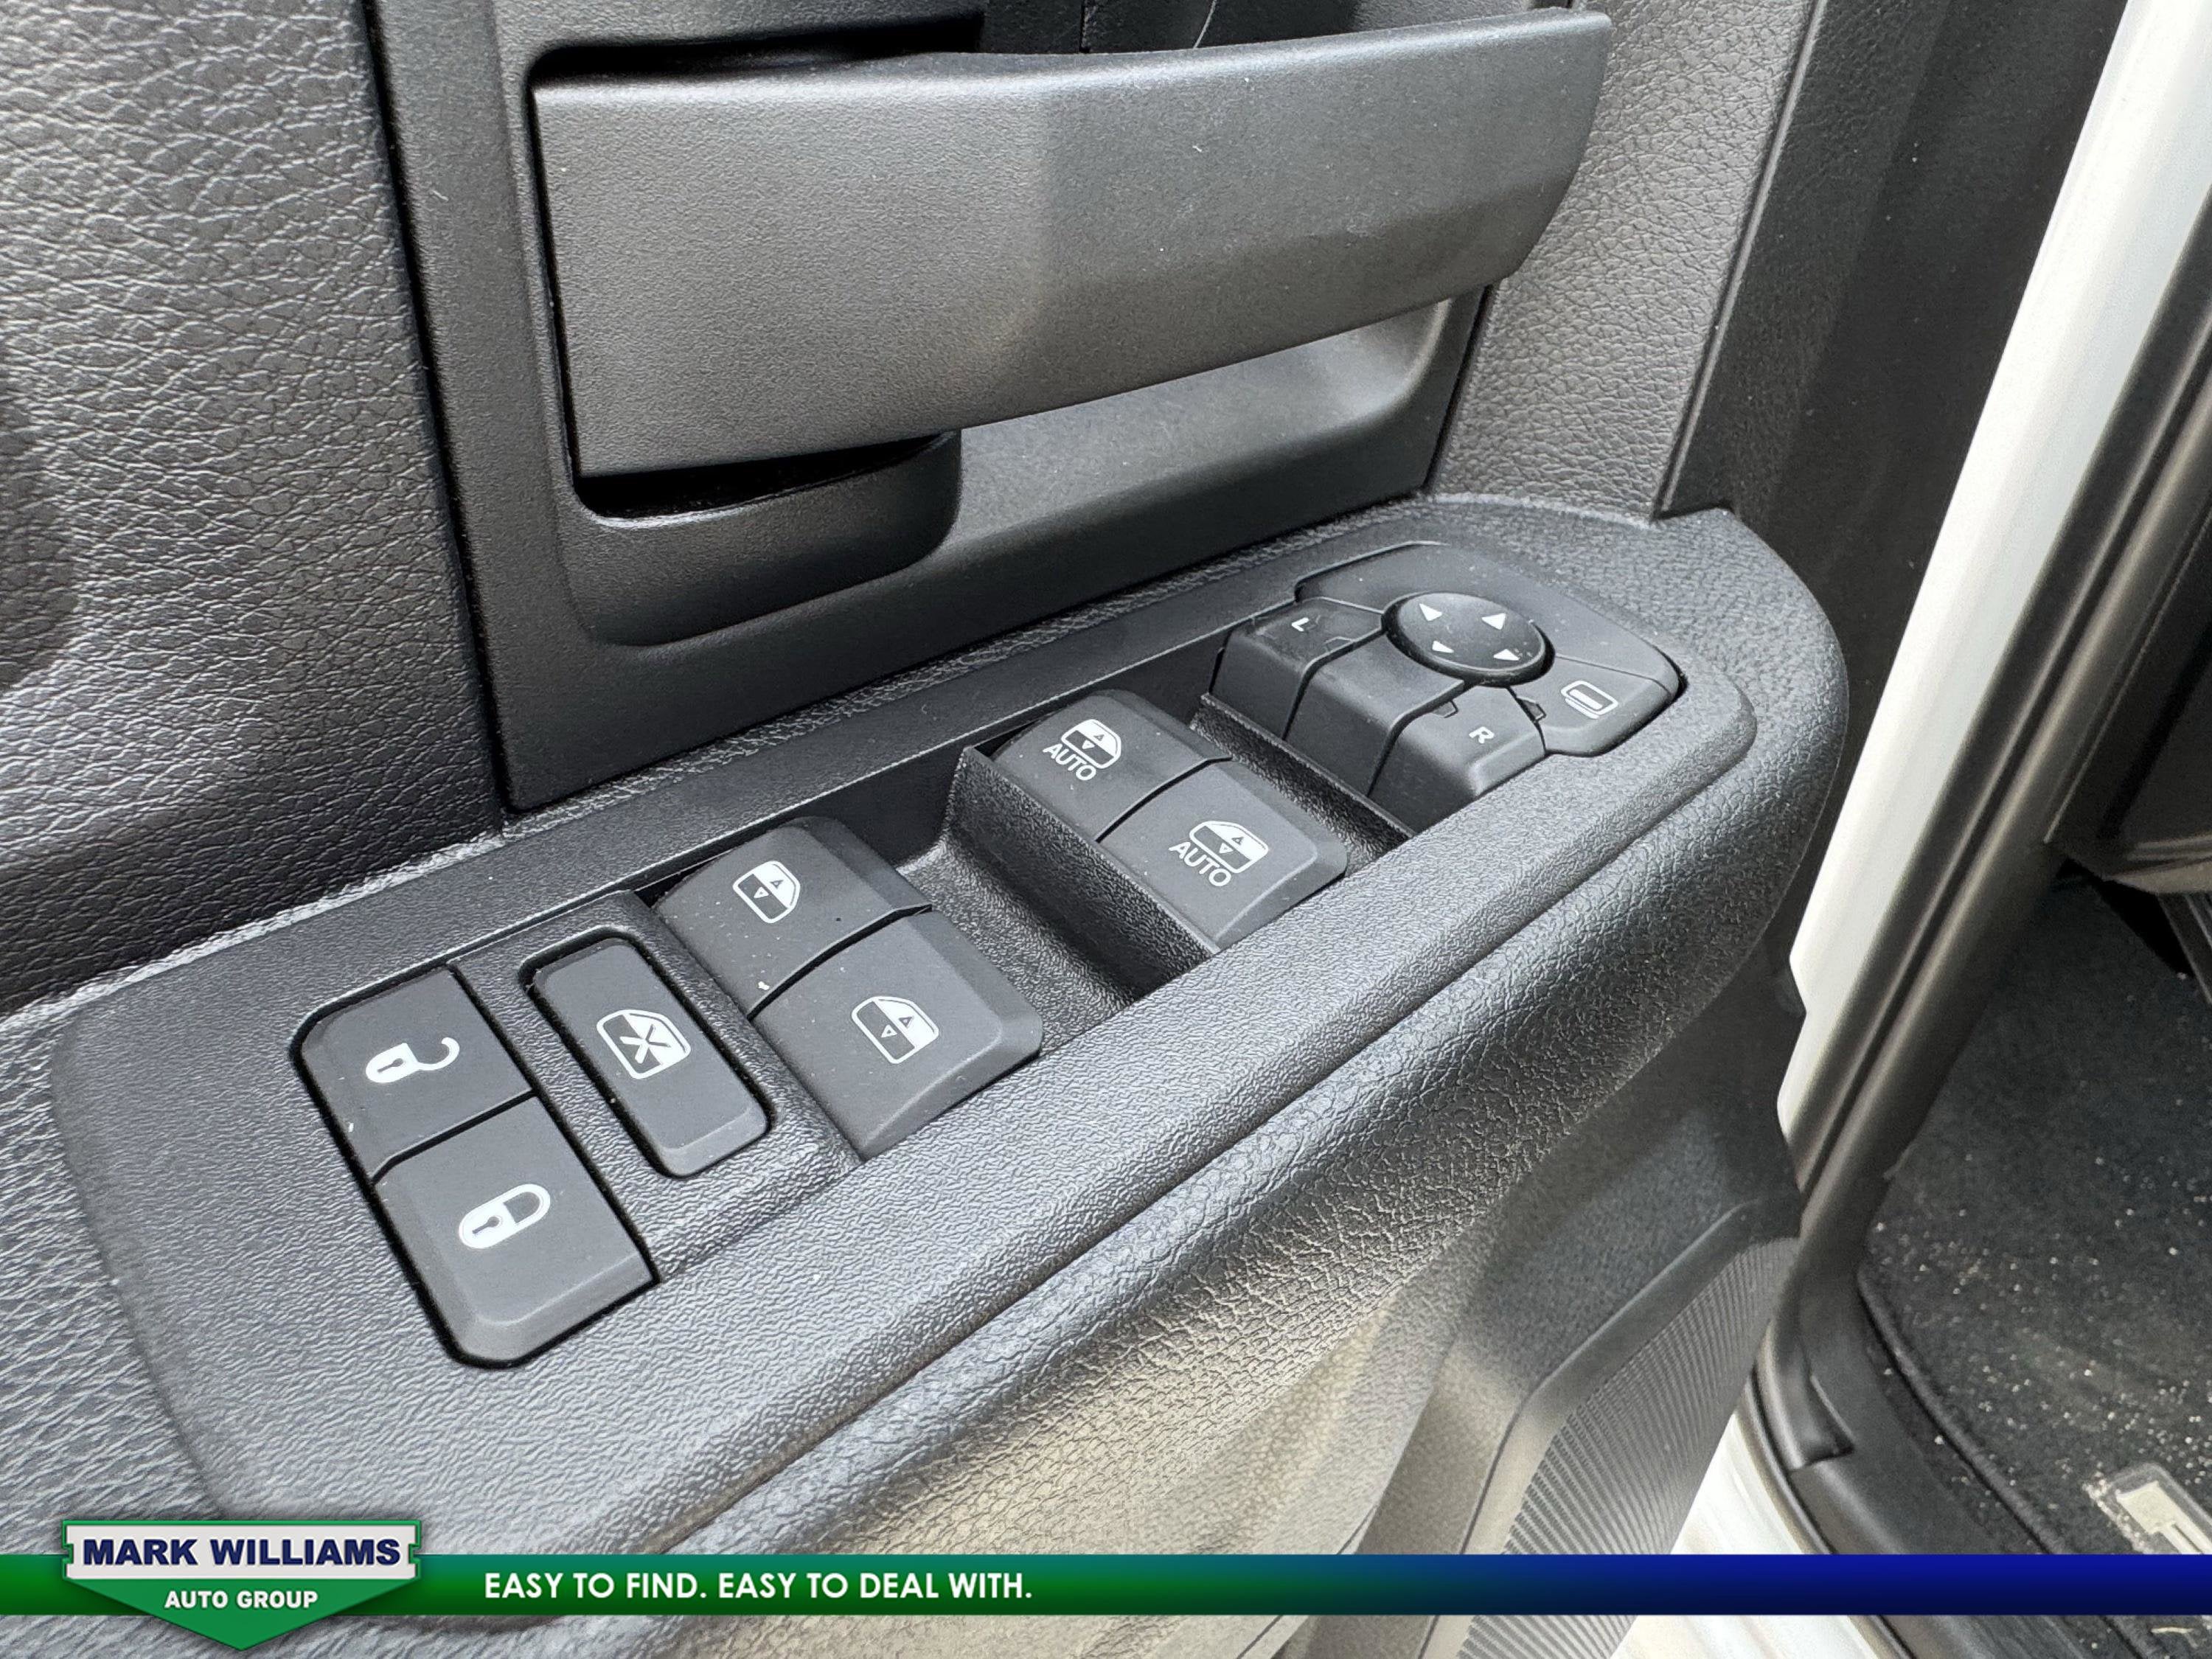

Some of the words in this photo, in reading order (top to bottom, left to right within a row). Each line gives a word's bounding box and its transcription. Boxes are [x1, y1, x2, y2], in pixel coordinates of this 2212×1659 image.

[1291, 616, 1310, 632] L
[1469, 726, 1495, 744] R
[1042, 743, 1096, 781] AUTO
[1168, 841, 1232, 887] AUTO
